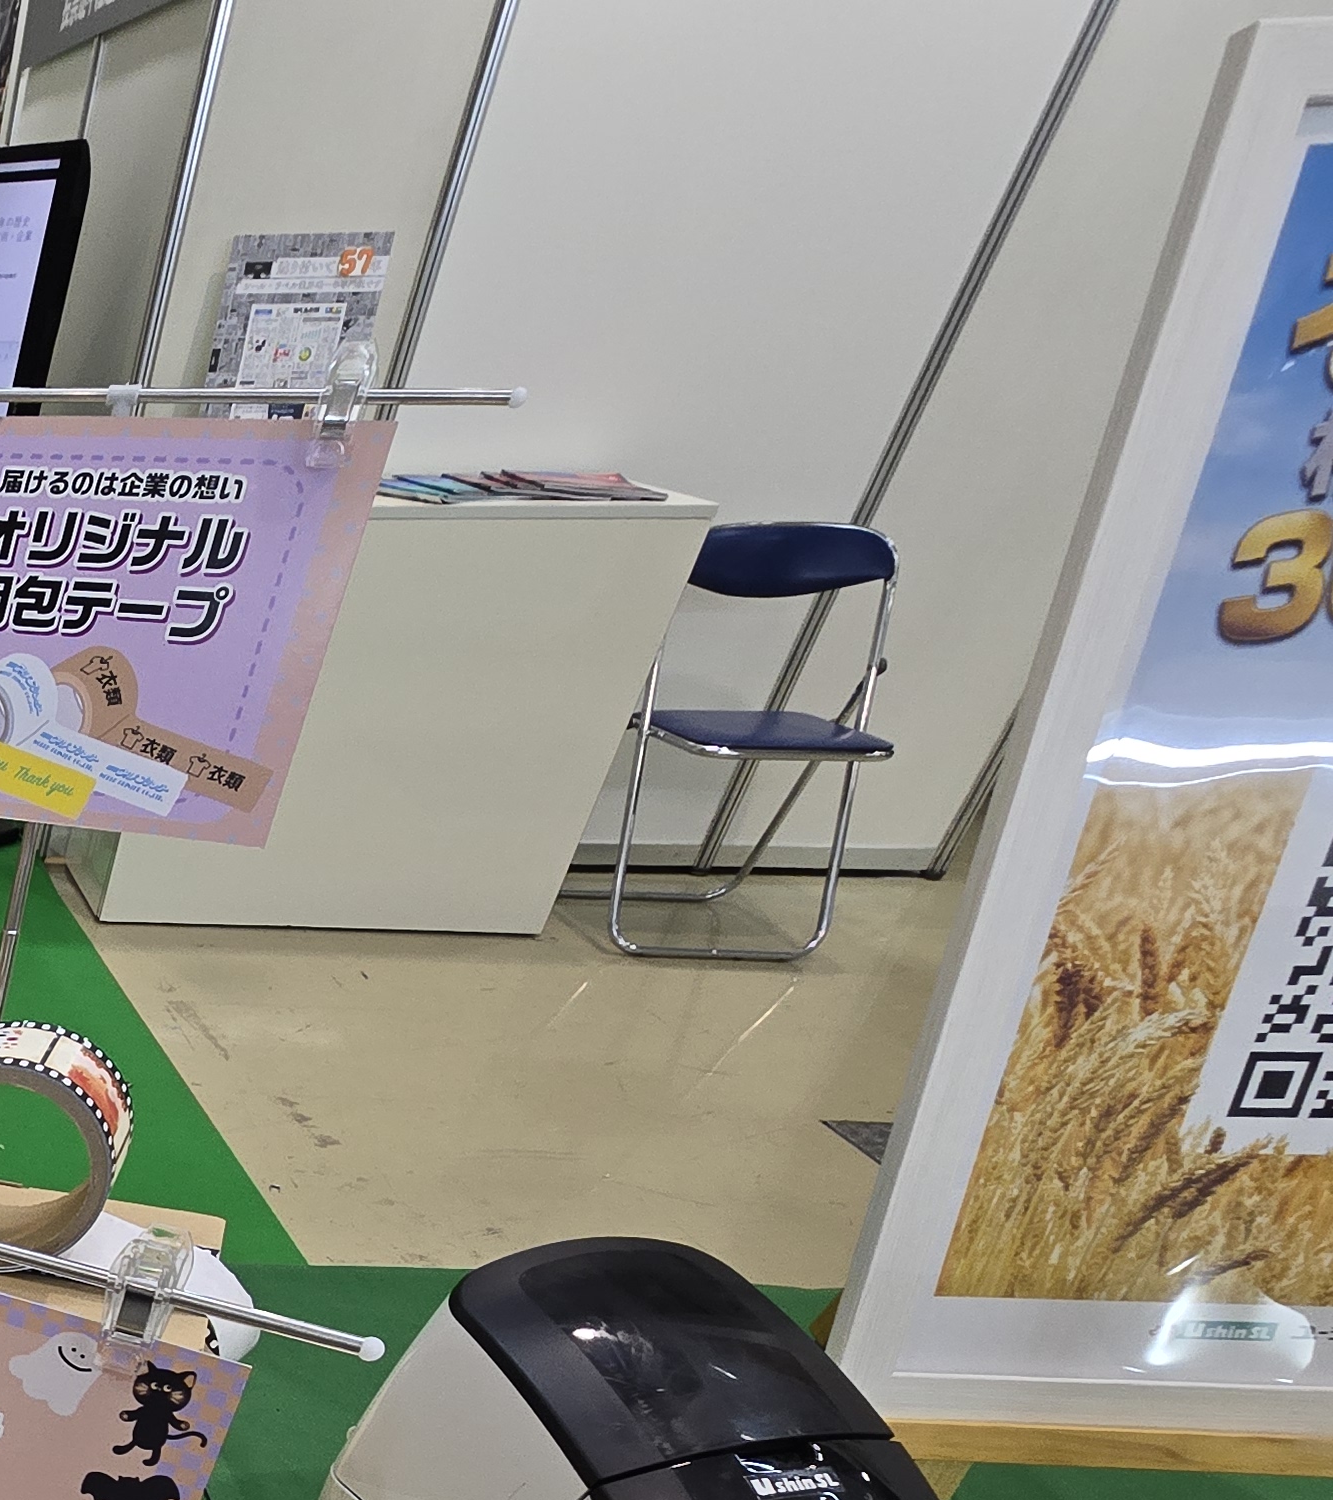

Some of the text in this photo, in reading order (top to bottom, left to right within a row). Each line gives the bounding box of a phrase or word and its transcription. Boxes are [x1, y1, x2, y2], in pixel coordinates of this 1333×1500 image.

[0, 470, 244, 501] 届けるのは企業の想い
[1219, 507, 1333, 643] 3
[96, 670, 123, 707] 衣類
[15, 765, 49, 789] Thank
[46, 778, 74, 798] you
[140, 737, 246, 793] 衣類 衣類
